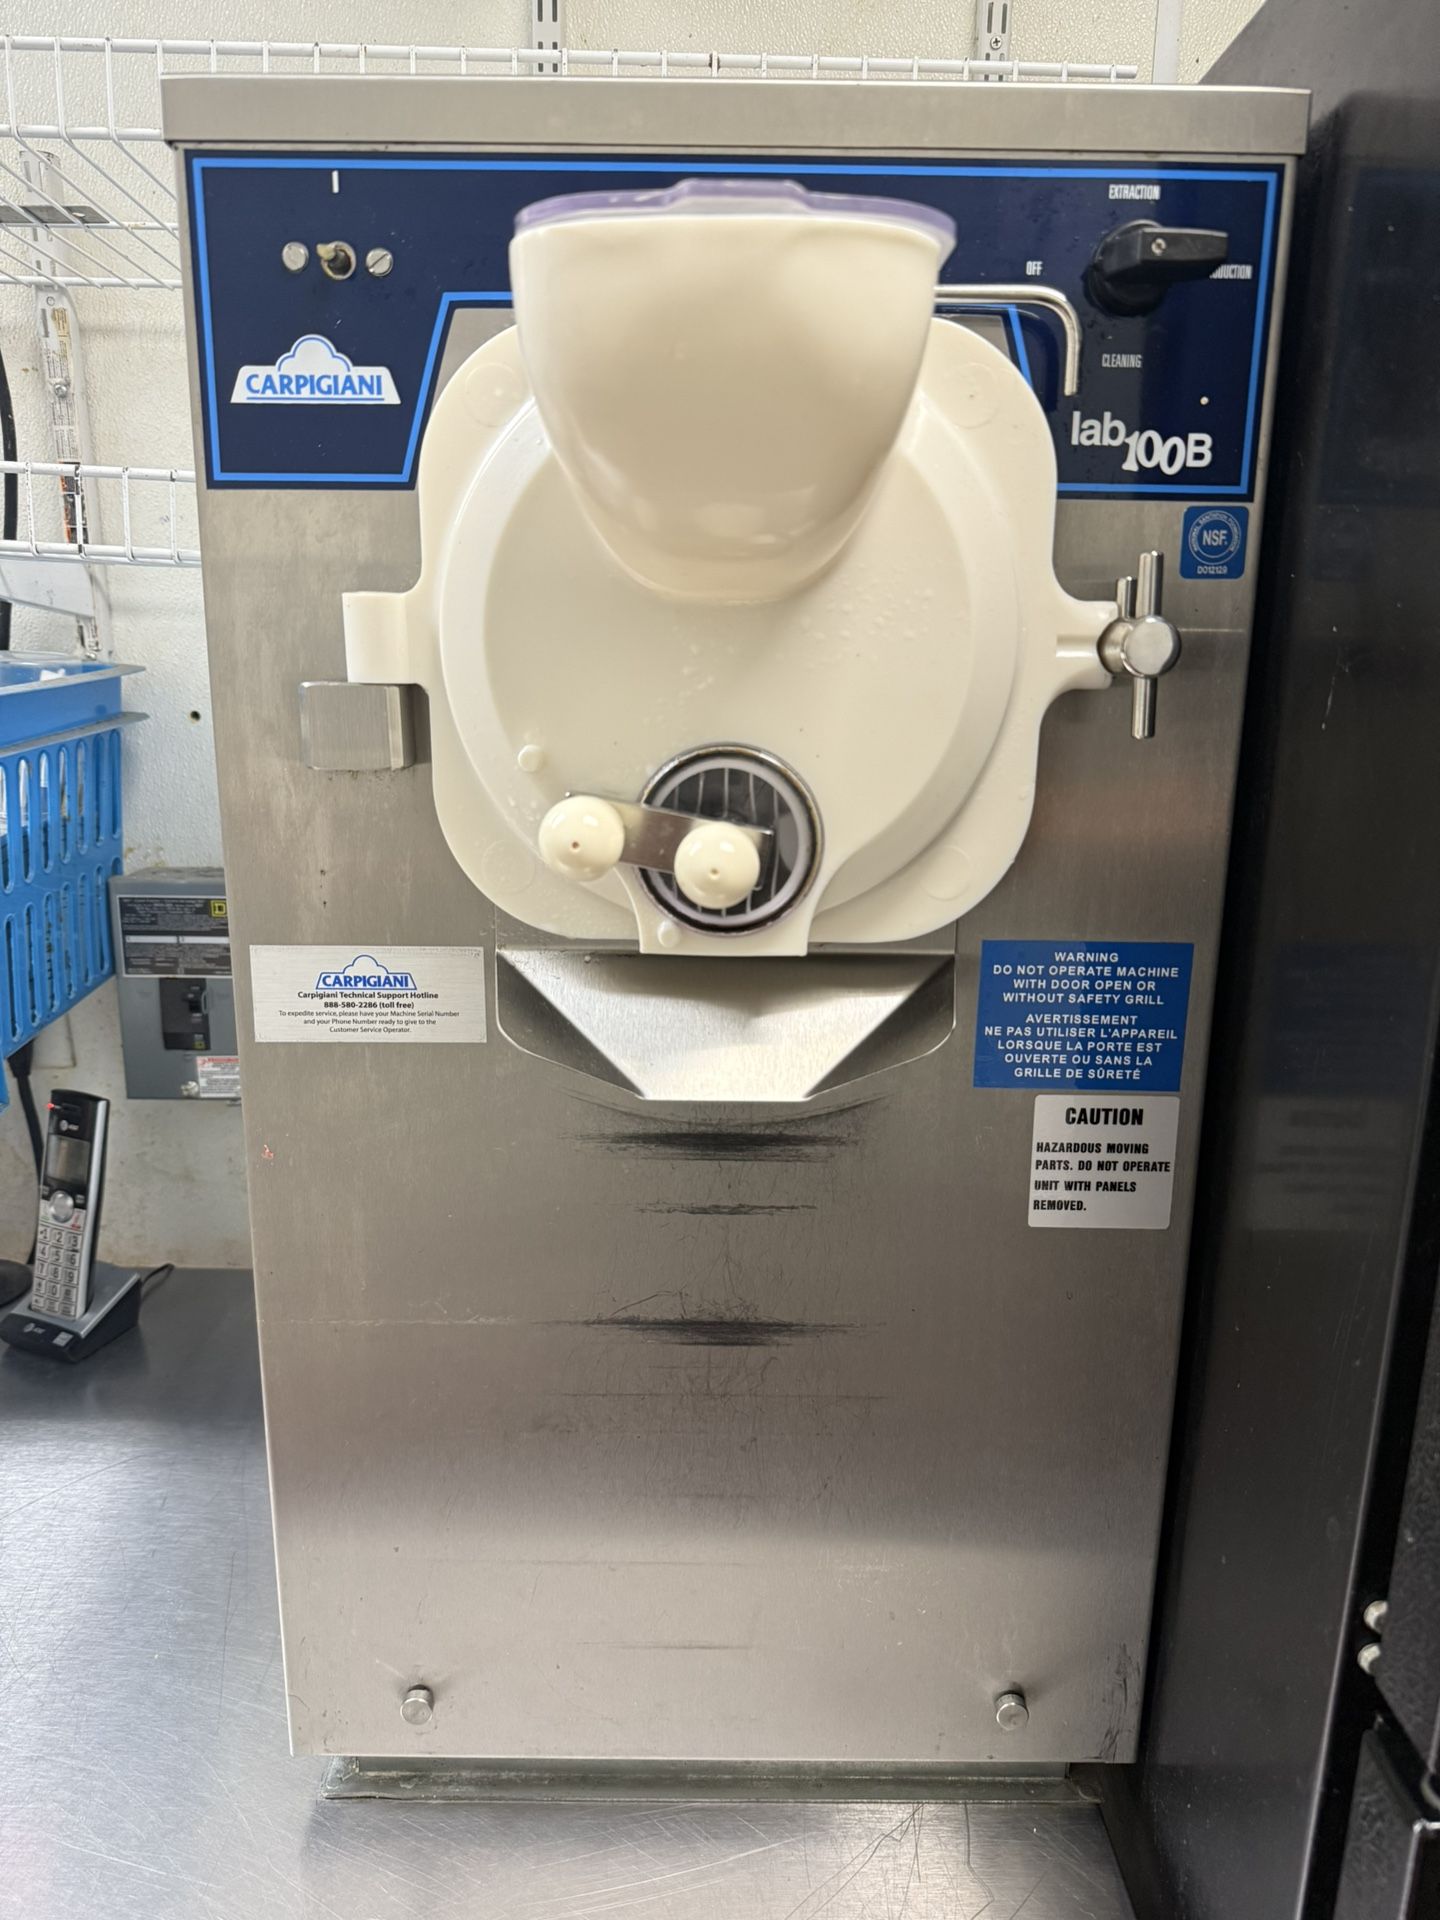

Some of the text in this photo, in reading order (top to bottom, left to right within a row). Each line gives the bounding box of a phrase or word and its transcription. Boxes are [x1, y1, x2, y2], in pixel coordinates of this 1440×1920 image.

[1108, 184, 1161, 200] EXTRACTION
[1025, 261, 1043, 276] OFF
[1101, 353, 1143, 368] CLEANING
[246, 374, 382, 395] CARPIGIANI
[1054, 952, 1119, 963] WARNING
[993, 965, 1179, 978] DO NOT OPERATE MACHINE
[322, 975, 408, 988] CARPIGIANI
[1013, 979, 1156, 991] WITH DOOR OPEN OR
[298, 991, 439, 1000] Carpigiani Technical Support Hotline
[1003, 992, 1165, 1005] WITHOUT SAFETY GRILL
[323, 1001, 415, 1010] 888-580-2286 (toll free)
[287, 1010, 314, 1018] expedite
[338, 1010, 358, 1018] please
[375, 1011, 389, 1019] your
[1025, 1014, 1138, 1025] AVERTISSEMENT
[383, 1026, 411, 1034] Operator.
[985, 1026, 1178, 1039] NE PAS UTILISER L'APPAREIL
[998, 1040, 1162, 1053] LORSQUE LA PORTE EST
[1004, 1053, 1152, 1066] OUVERTE OU SANS LA
[1014, 1067, 1141, 1080] GRILLE DE SÛRETÉ
[1065, 1107, 1144, 1126] CAUTION
[1036, 1142, 1149, 1154] HAZARDOUS MOVING
[1035, 1160, 1171, 1172] PARTS. DO NOT OPERATE
[1034, 1180, 1137, 1192] UNIT WITH PANELS
[1033, 1199, 1087, 1211] REMOVED.
